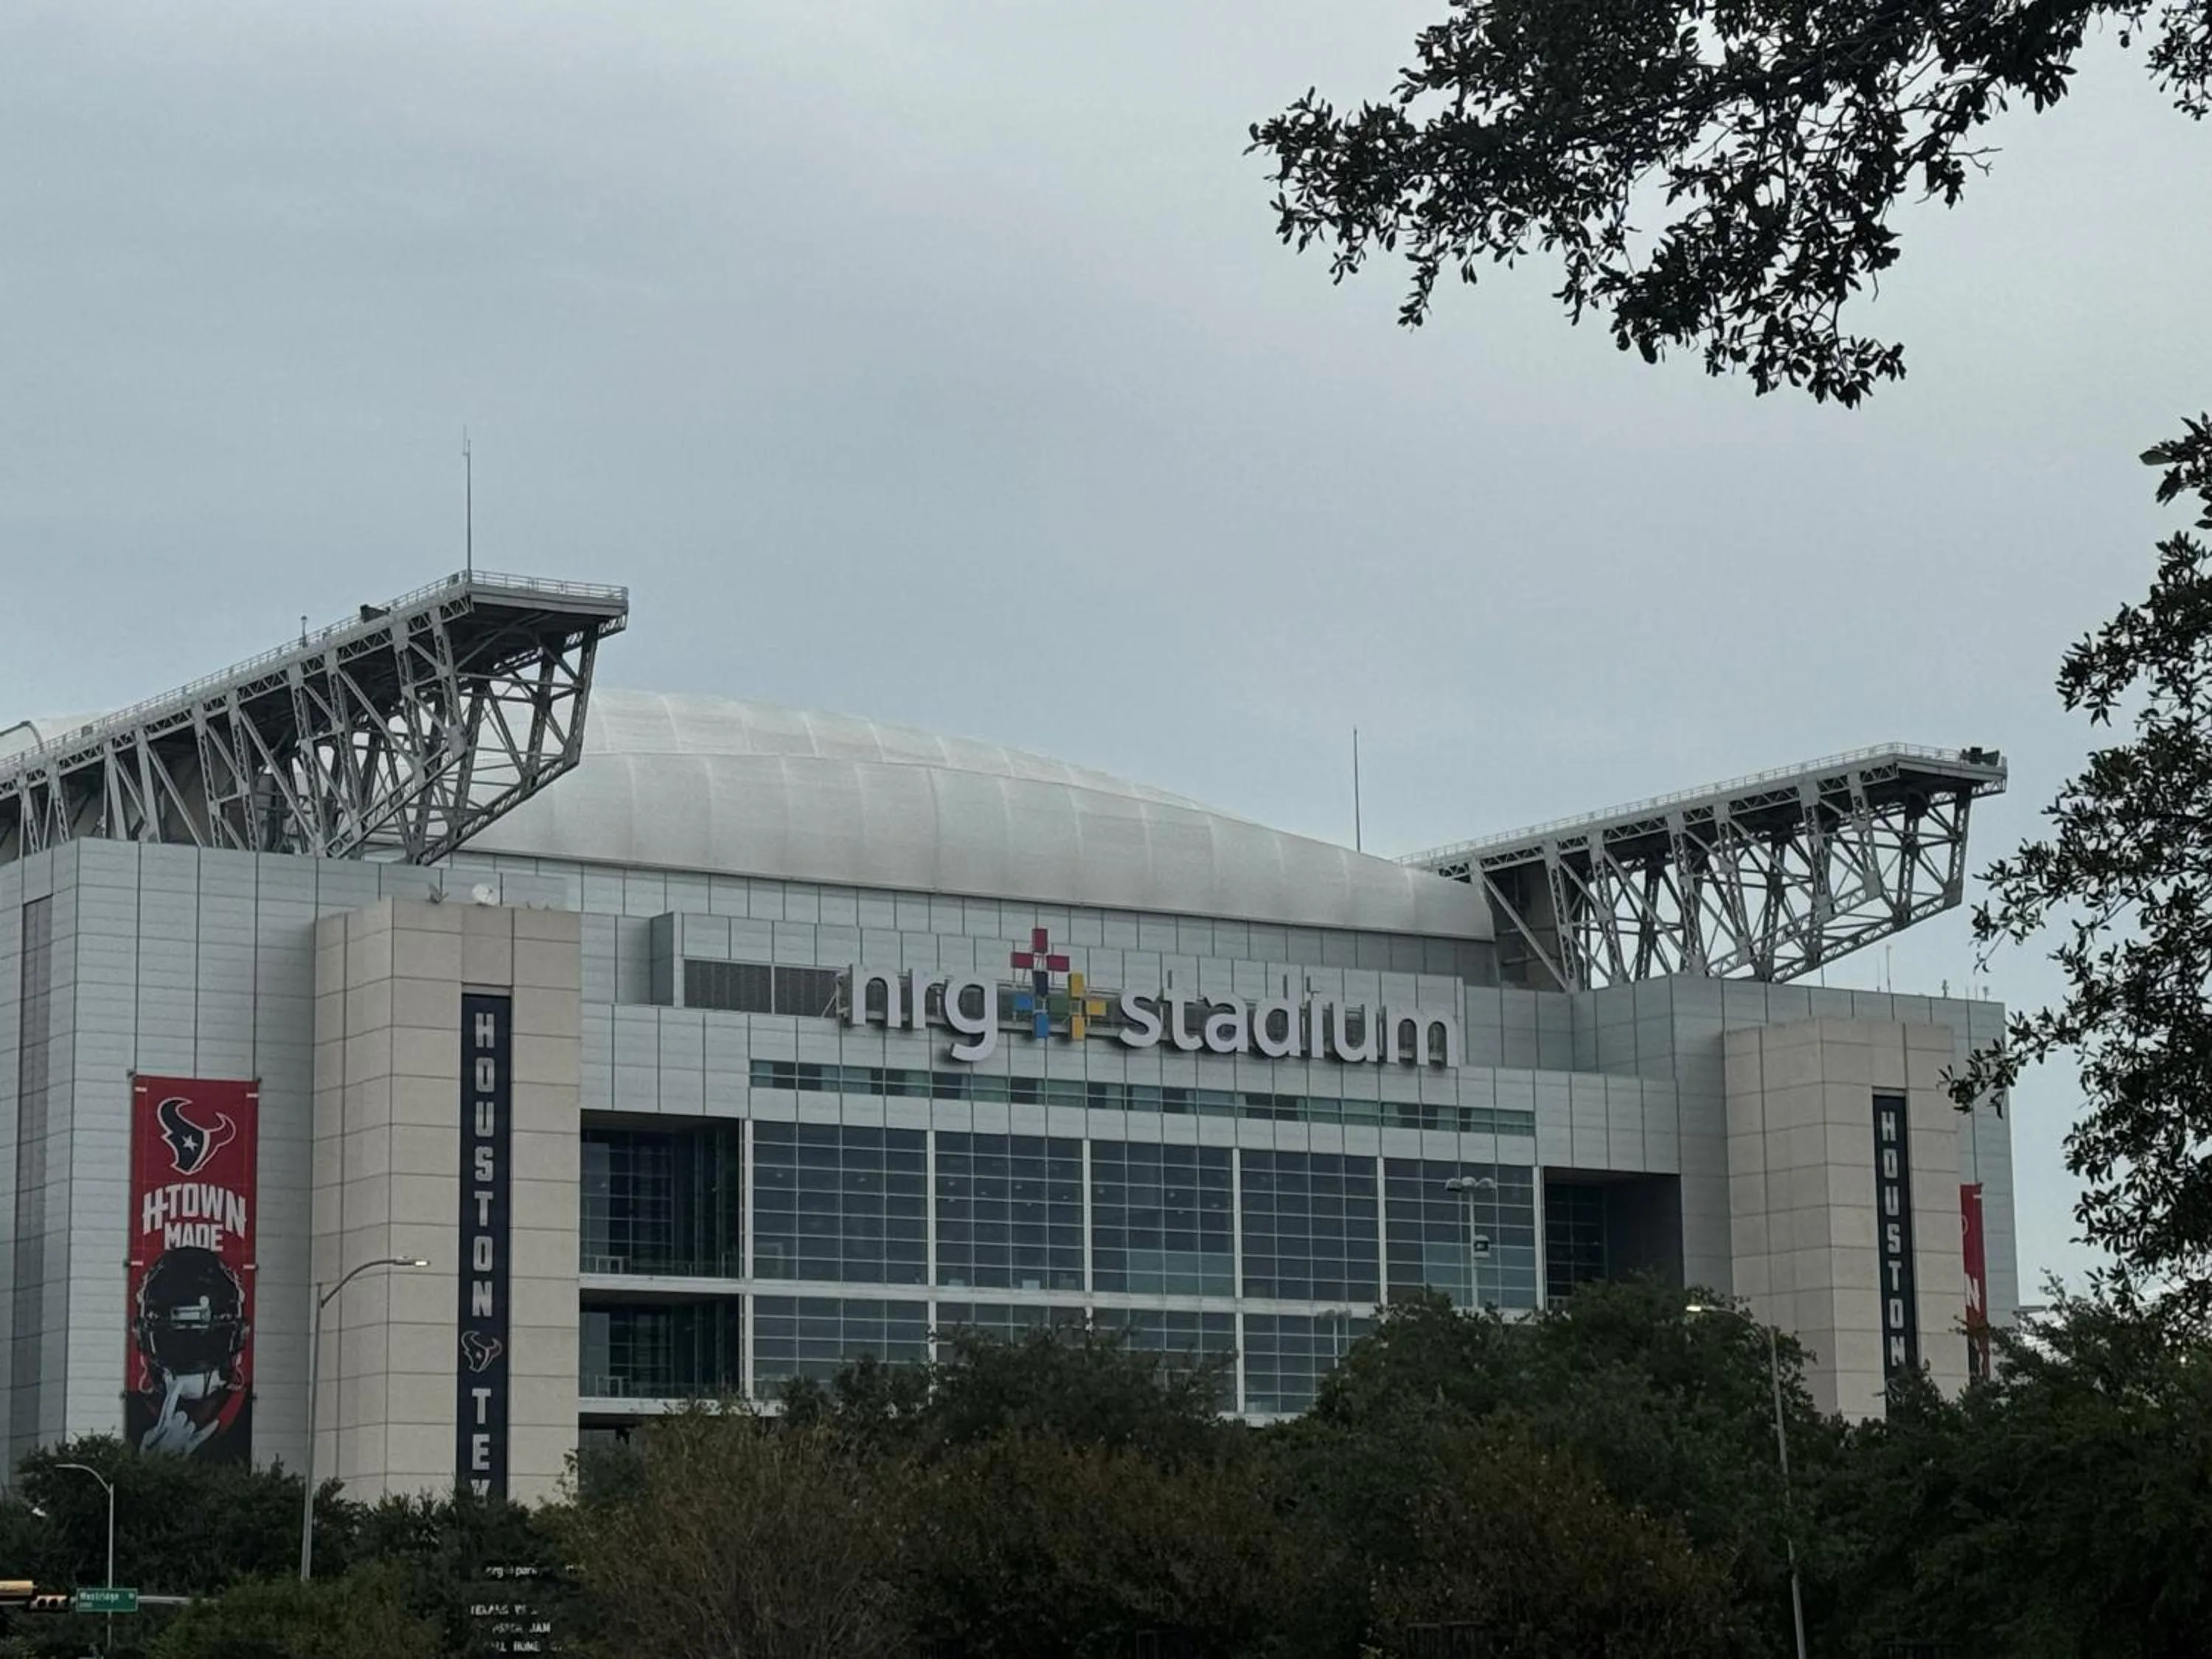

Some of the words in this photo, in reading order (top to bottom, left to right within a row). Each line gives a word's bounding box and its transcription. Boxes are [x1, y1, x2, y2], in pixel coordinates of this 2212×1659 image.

[849, 964, 998, 1062] nrg
[1119, 971, 1459, 1067] stadium
[164, 1222, 224, 1251] MADE
[472, 1012, 495, 1318] HOUSTON
[1881, 1110, 1907, 1367] HOUSTON
